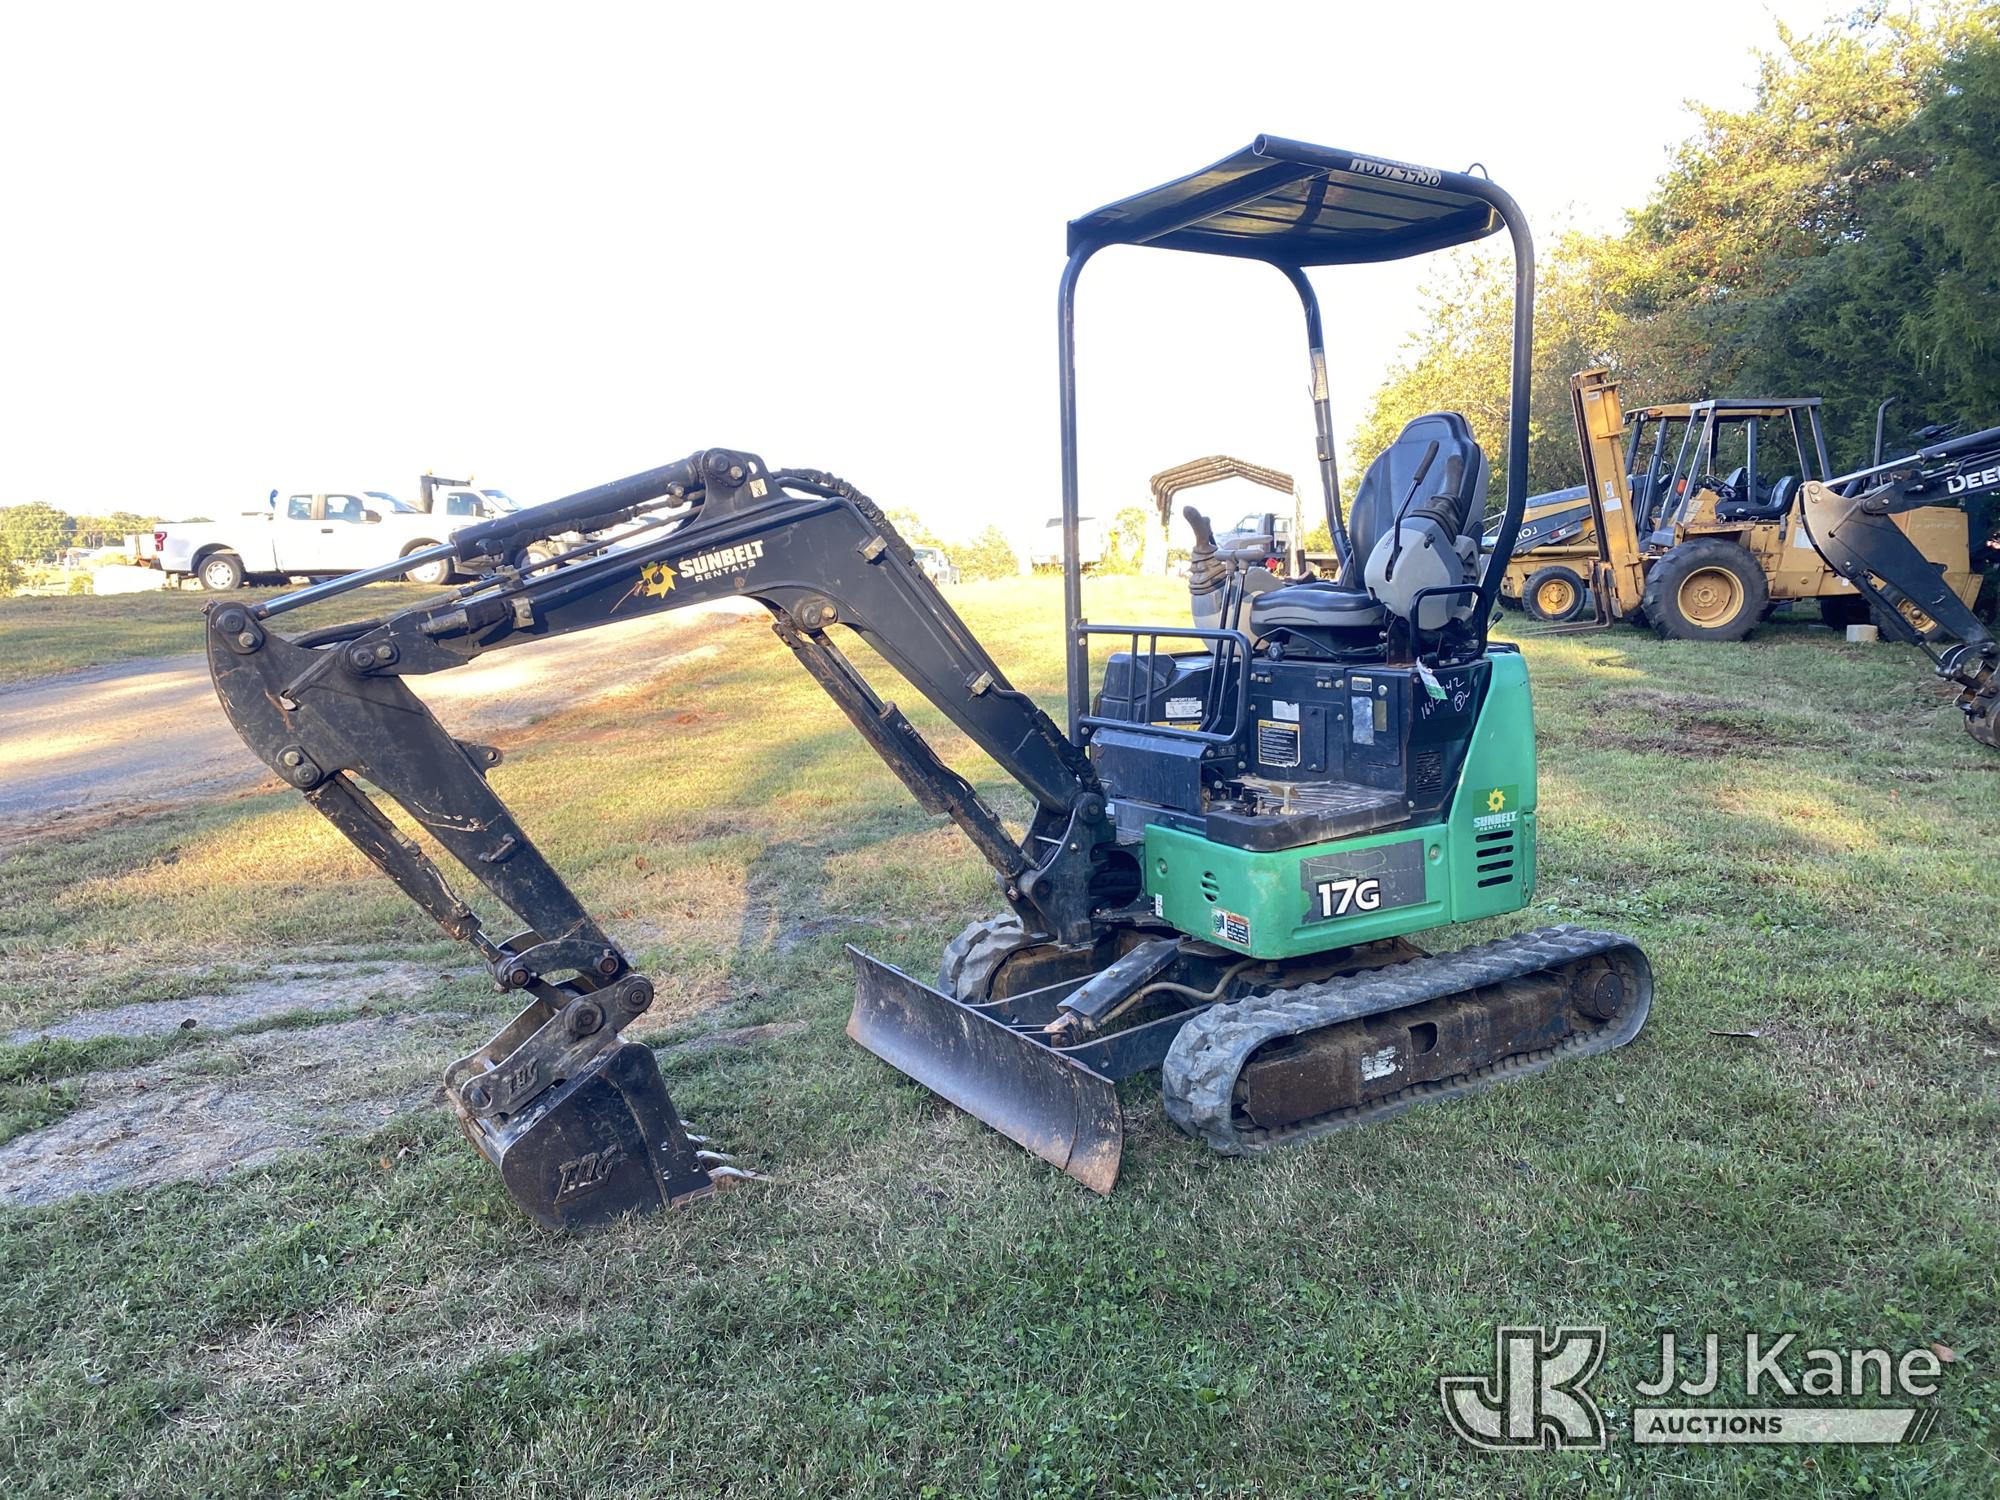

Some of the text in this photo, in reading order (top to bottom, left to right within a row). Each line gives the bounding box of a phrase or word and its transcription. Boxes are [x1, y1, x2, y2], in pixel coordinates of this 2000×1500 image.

[1946, 466, 2000, 494] DEE
[678, 540, 764, 578] SUNBELT
[695, 560, 757, 583] RENTALS
[1473, 811, 1518, 828] SUNBELT
[1317, 877, 1381, 918] 17G
